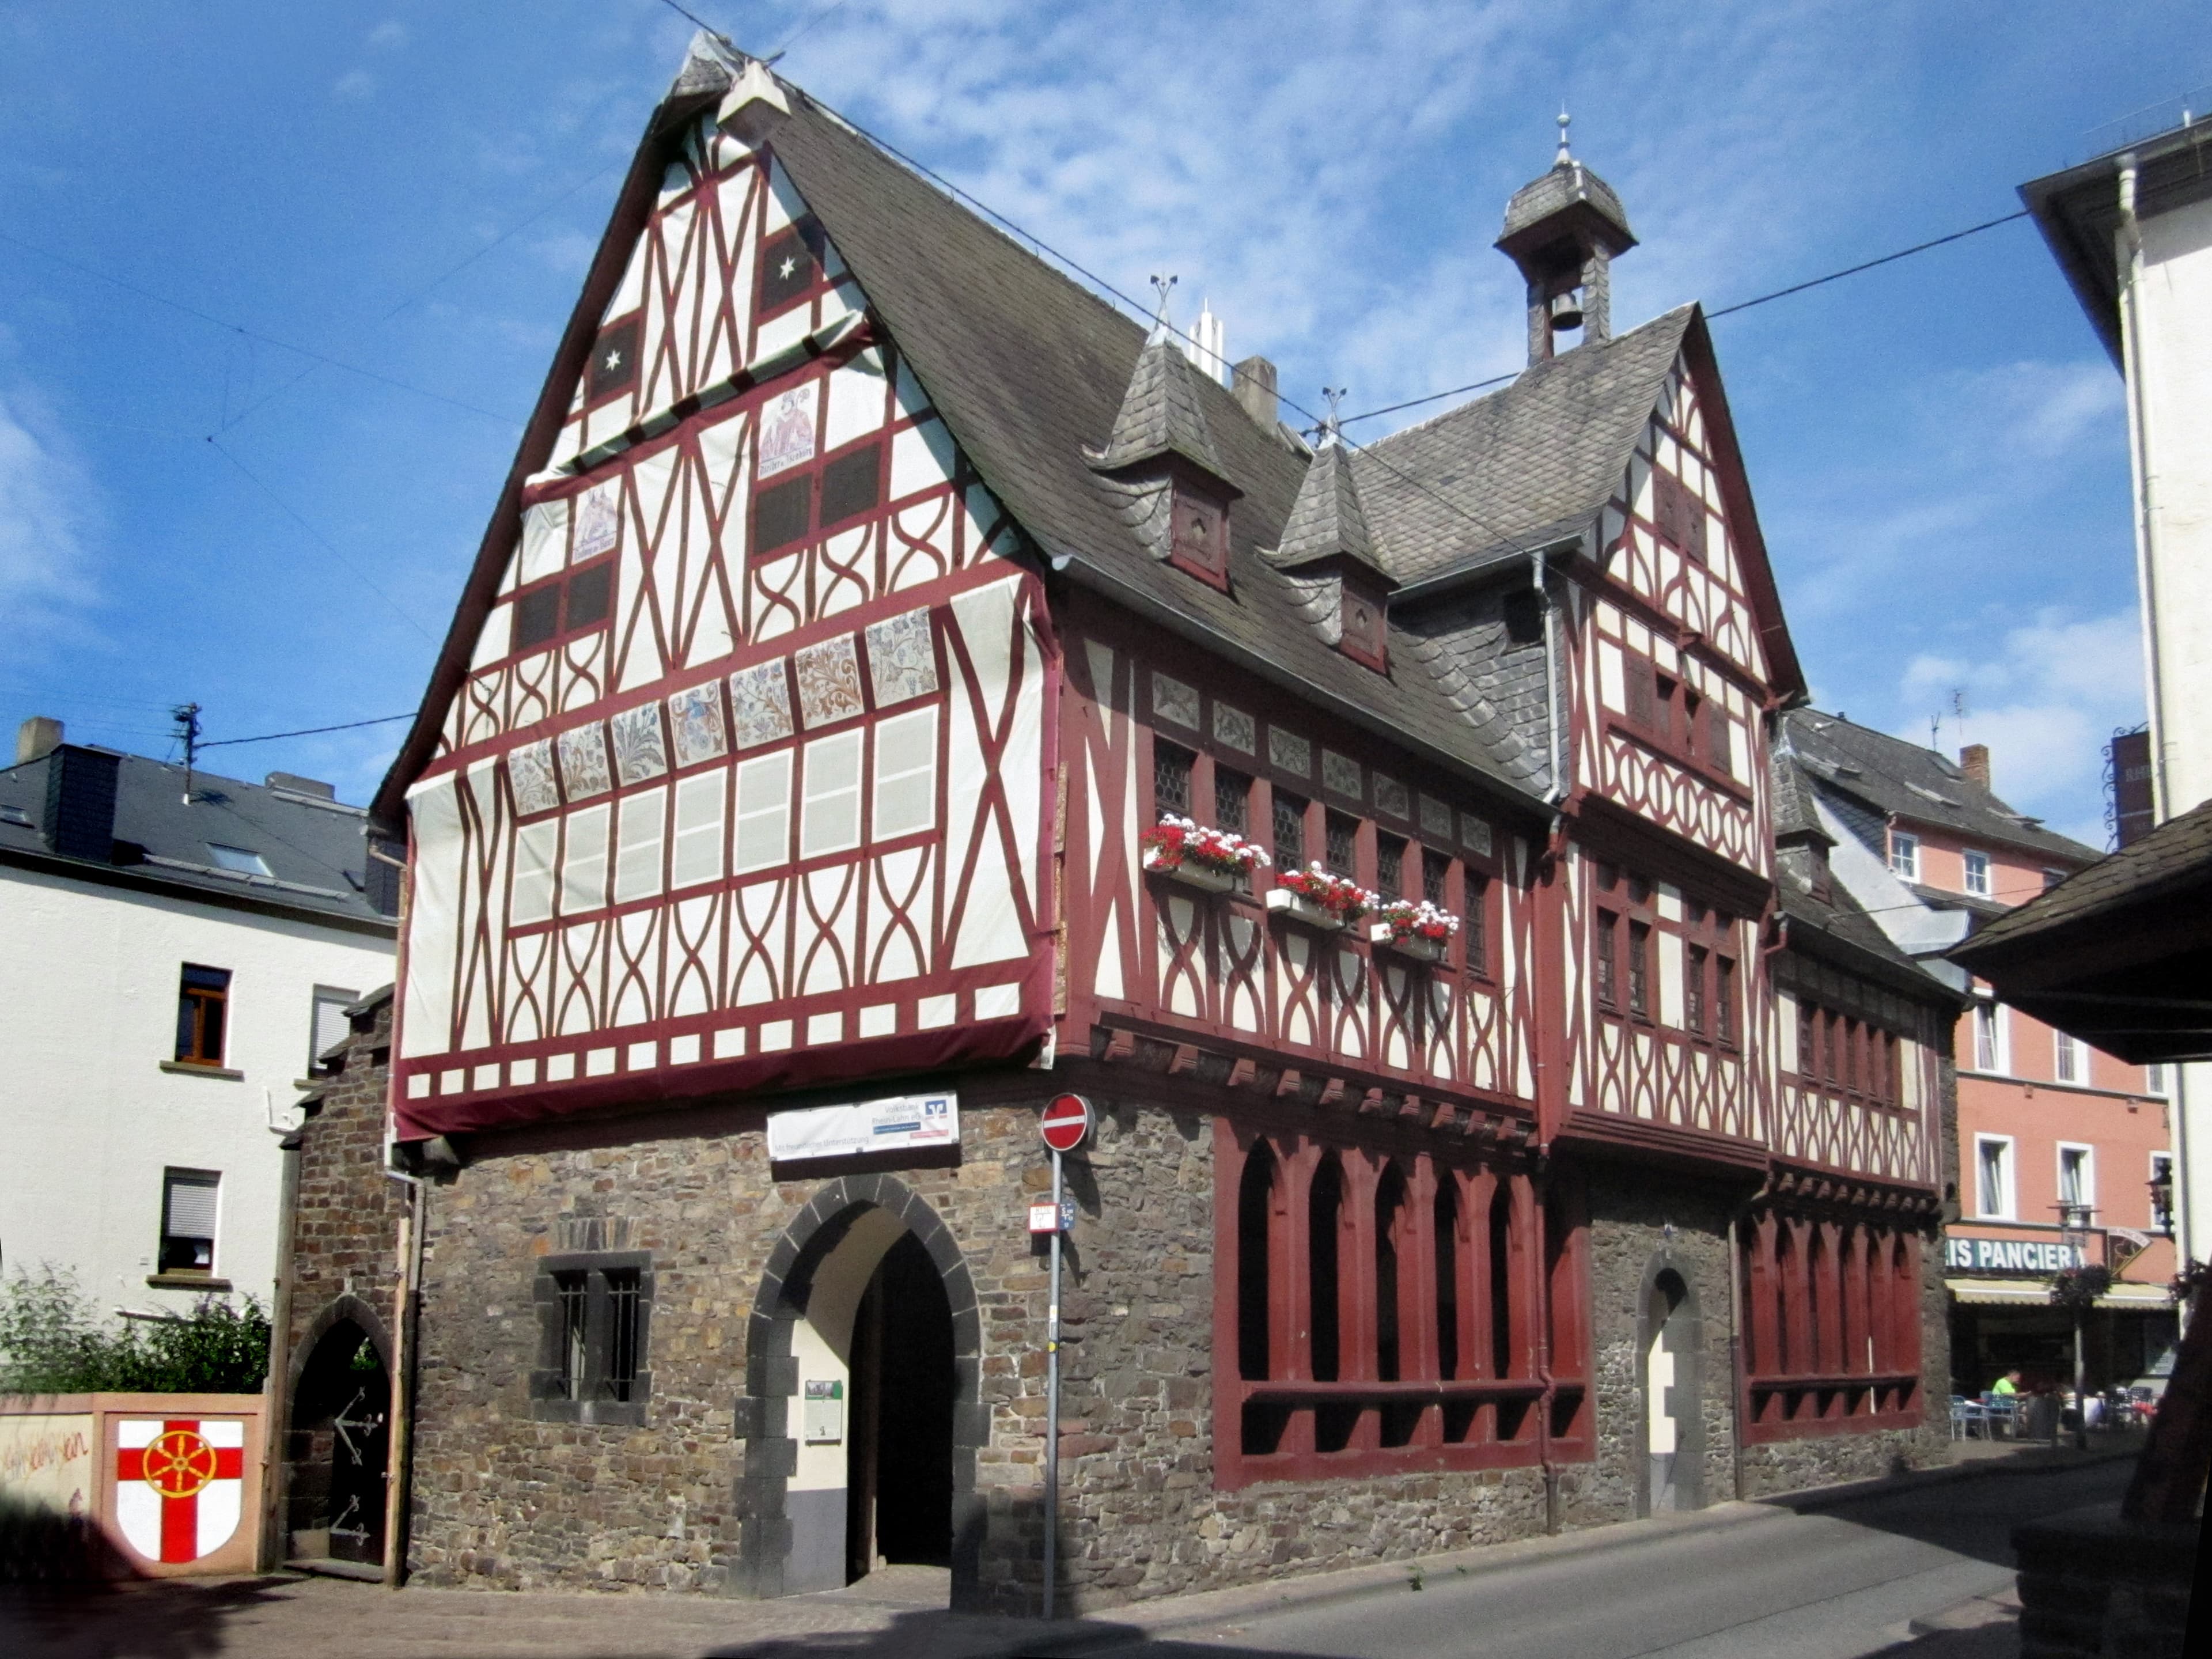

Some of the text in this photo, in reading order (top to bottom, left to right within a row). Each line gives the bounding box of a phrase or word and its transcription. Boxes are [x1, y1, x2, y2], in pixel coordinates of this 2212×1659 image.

[884, 1103, 919, 1113] Volksbank
[824, 1137, 869, 1147] Unterstützung
[1945, 1239, 1972, 1267] IS
